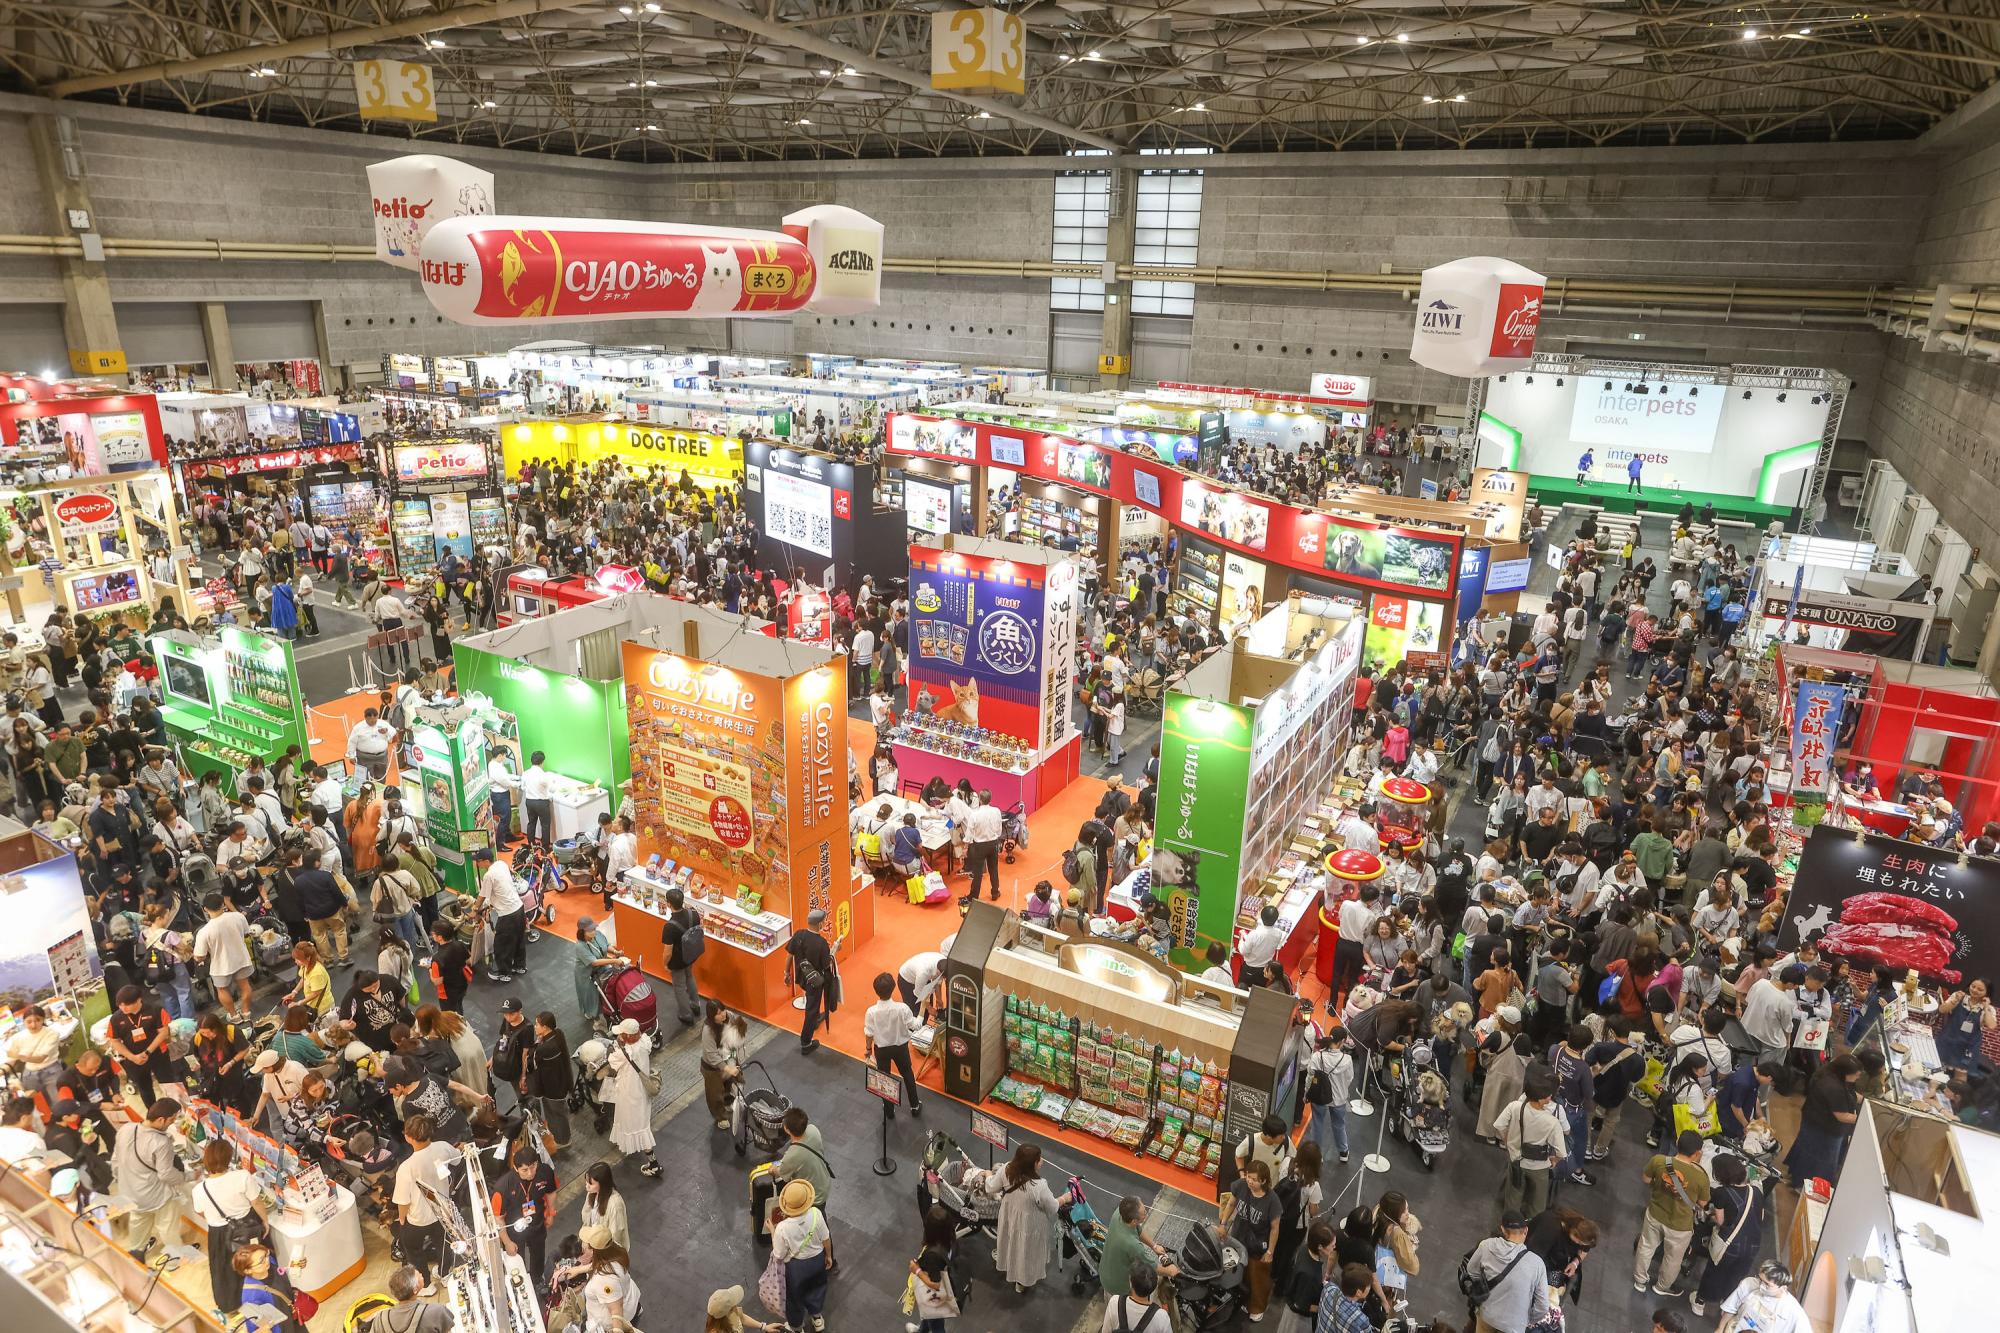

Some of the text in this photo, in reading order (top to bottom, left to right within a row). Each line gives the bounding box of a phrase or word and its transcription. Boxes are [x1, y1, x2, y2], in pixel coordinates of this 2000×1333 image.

[948, 9, 985, 73] 3
[1002, 14, 1023, 79] 3
[364, 60, 385, 108] 3
[401, 62, 431, 110] 3
[373, 196, 433, 219] Petio
[828, 249, 874, 271] ACANA
[564, 260, 640, 302] CIAO
[752, 271, 787, 289] まぐろ
[1422, 312, 1463, 329] ZIWI
[1502, 309, 1537, 348] Orijen
[1323, 377, 1356, 393] Smac
[1597, 391, 1697, 417] interpets
[1594, 415, 1629, 426] OSAKA
[631, 432, 708, 458] DOGTREE
[1607, 447, 1669, 465] intepets
[259, 452, 297, 469] Petio
[417, 455, 467, 470] Petio
[1605, 462, 1627, 470] OSAKA
[1482, 479, 1515, 492] ZIWI
[60, 502, 112, 516] 日本ペットフード
[1125, 512, 1149, 523] ZIWI
[1460, 561, 1480, 575] IWI
[1377, 606, 1402, 625] Orijen
[1824, 607, 1897, 631] UNATO
[990, 615, 1024, 652] 魚
[990, 651, 1023, 666] づくし
[648, 660, 755, 712] CozyLife
[814, 702, 834, 819] CozyLife
[1881, 852, 1947, 879] 生肉に
[1856, 865, 1965, 900] 埋もれたい
